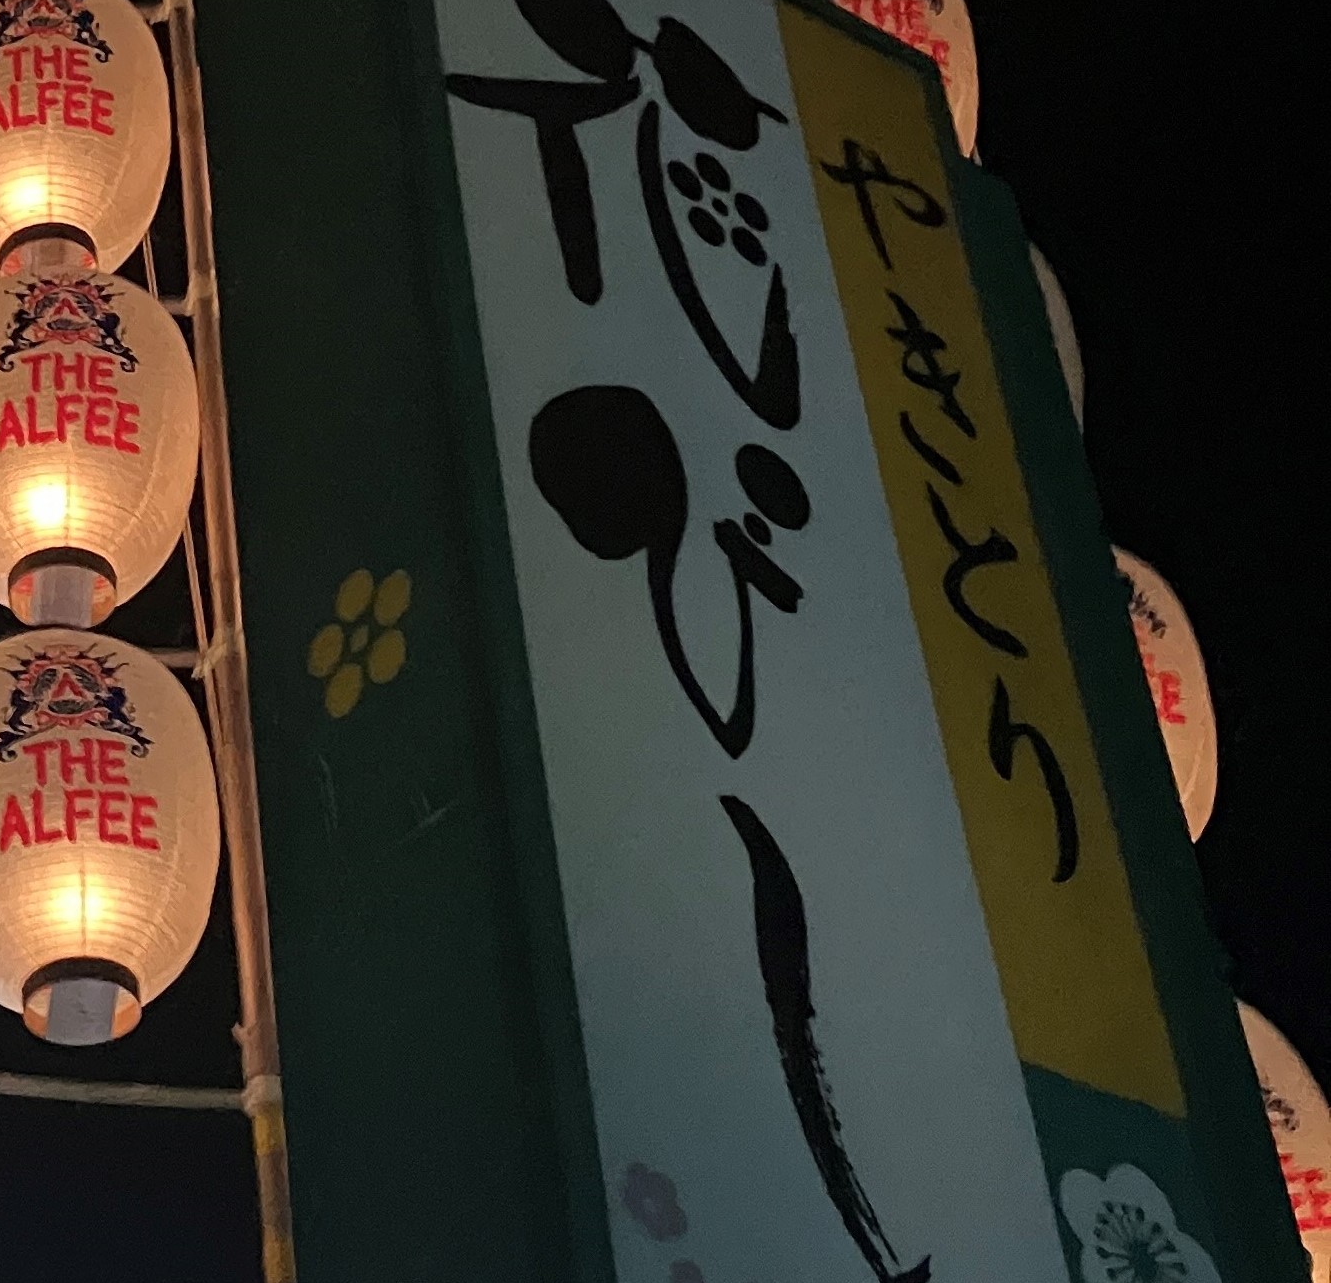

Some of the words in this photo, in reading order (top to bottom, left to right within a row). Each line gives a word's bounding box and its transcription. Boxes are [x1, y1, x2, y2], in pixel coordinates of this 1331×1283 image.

[4, 47, 94, 83] THE
[21, 352, 118, 396] THE
[822, 136, 1079, 886] やきとり
[23, 739, 129, 787] THE
